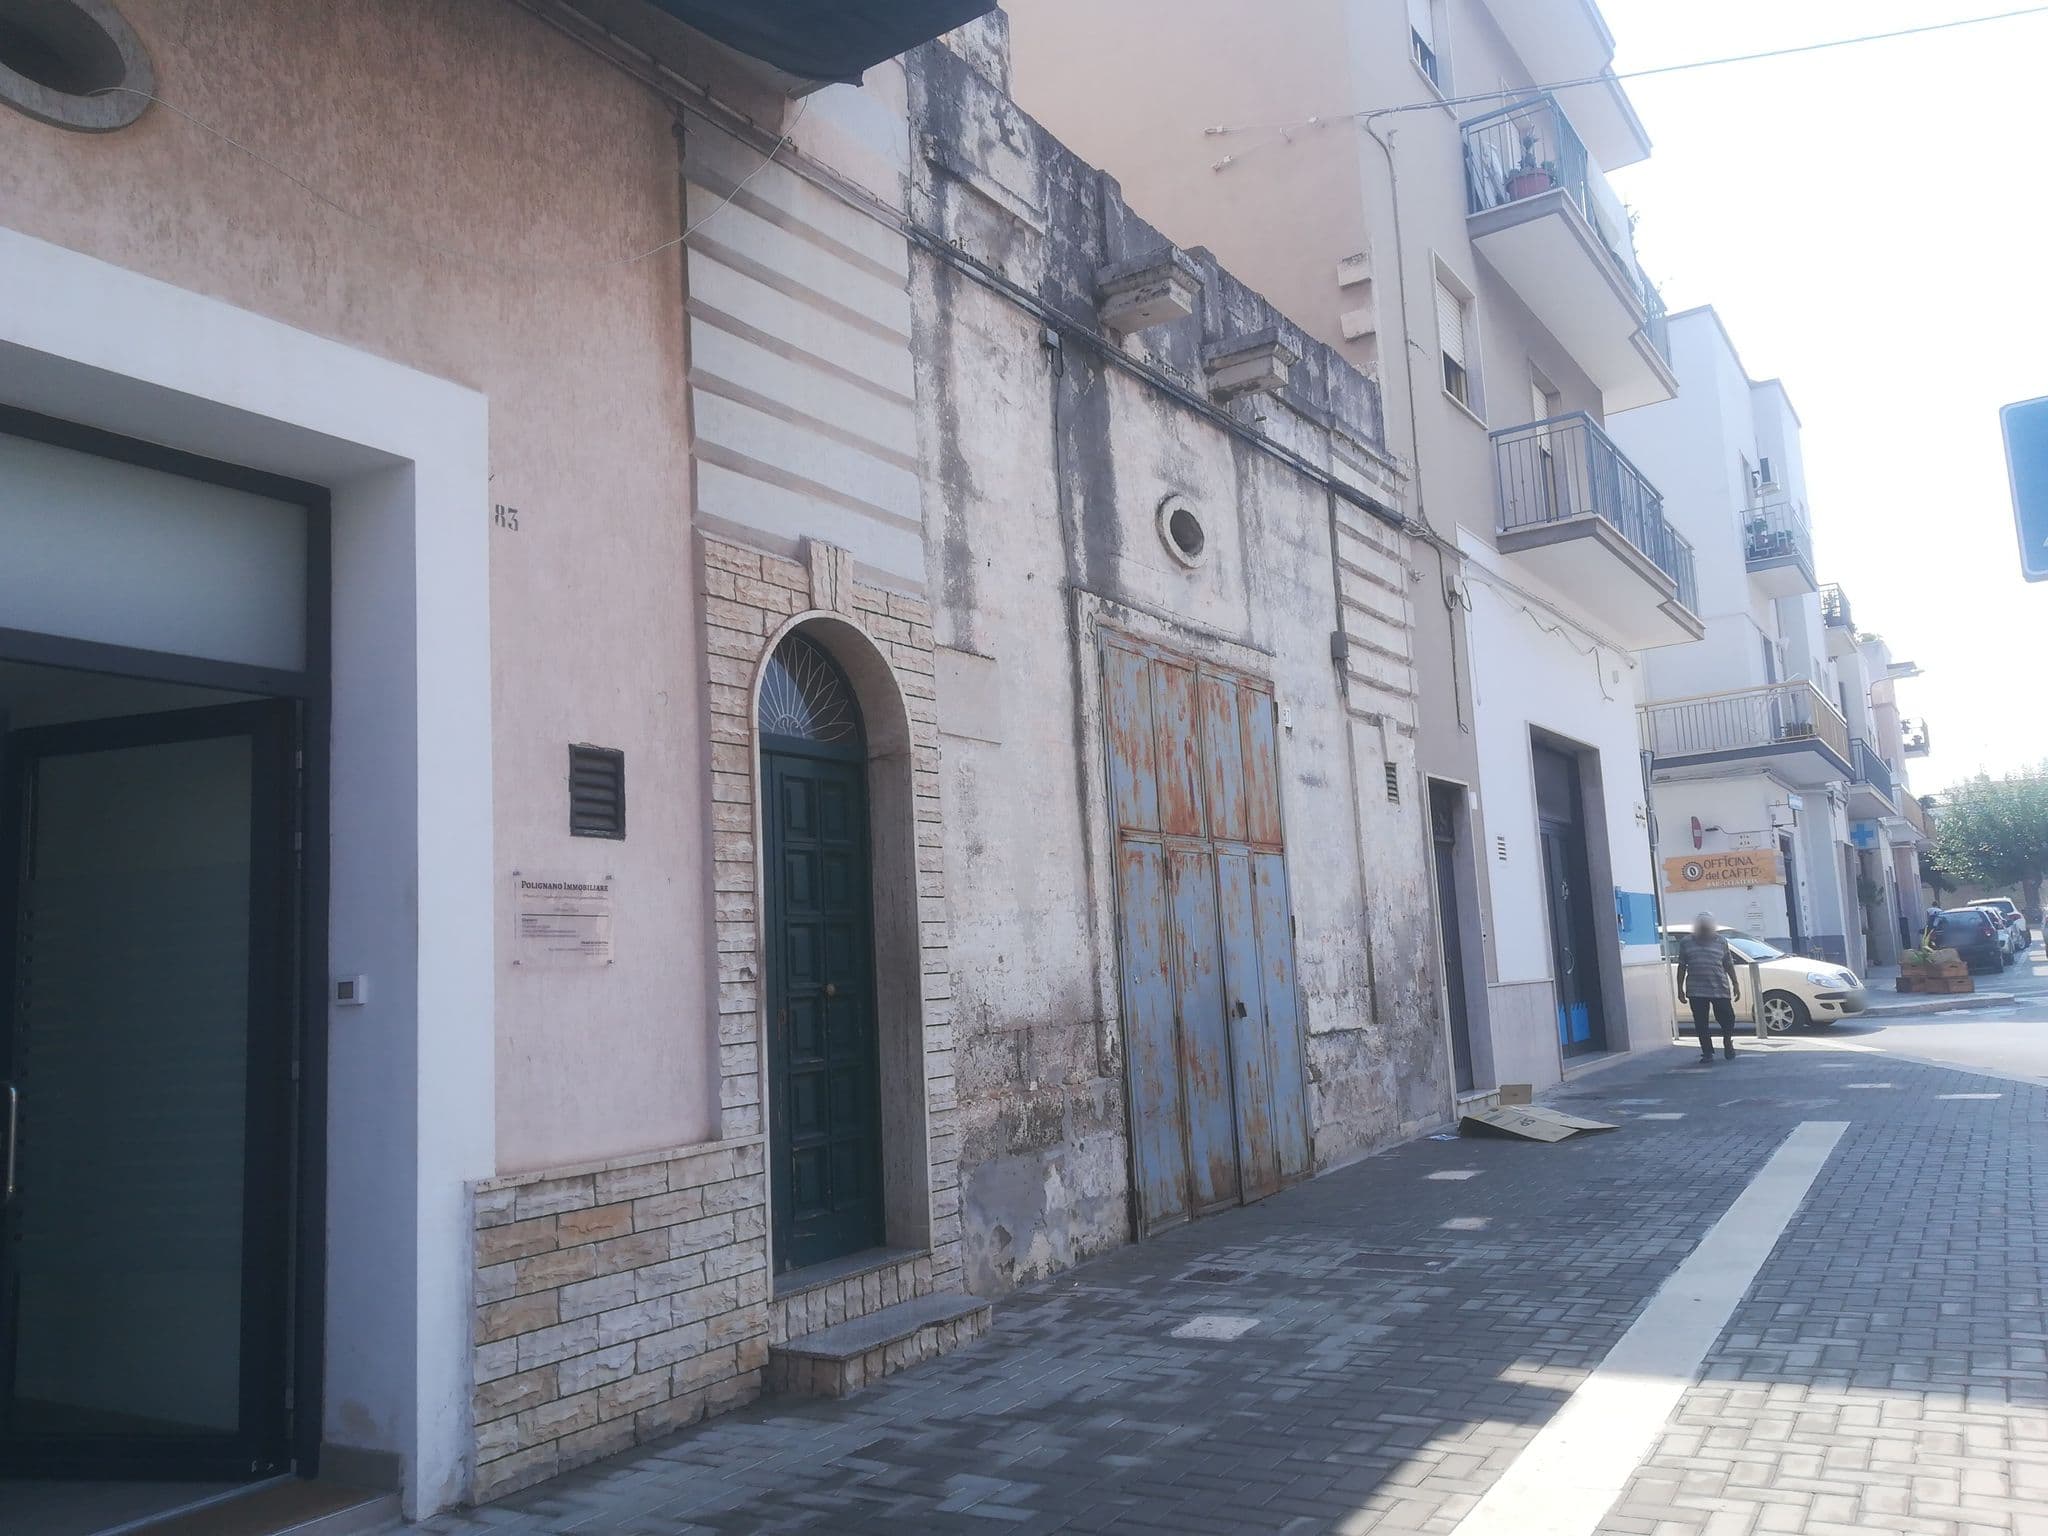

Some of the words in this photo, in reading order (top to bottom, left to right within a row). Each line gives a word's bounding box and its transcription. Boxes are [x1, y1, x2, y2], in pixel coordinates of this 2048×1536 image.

[495, 504, 519, 532] 83
[1703, 856, 1754, 869] OFFICINA
[1705, 871, 1720, 880] del
[521, 880, 563, 890] POLIGNANO
[563, 882, 609, 892] IMMOBILIARE
